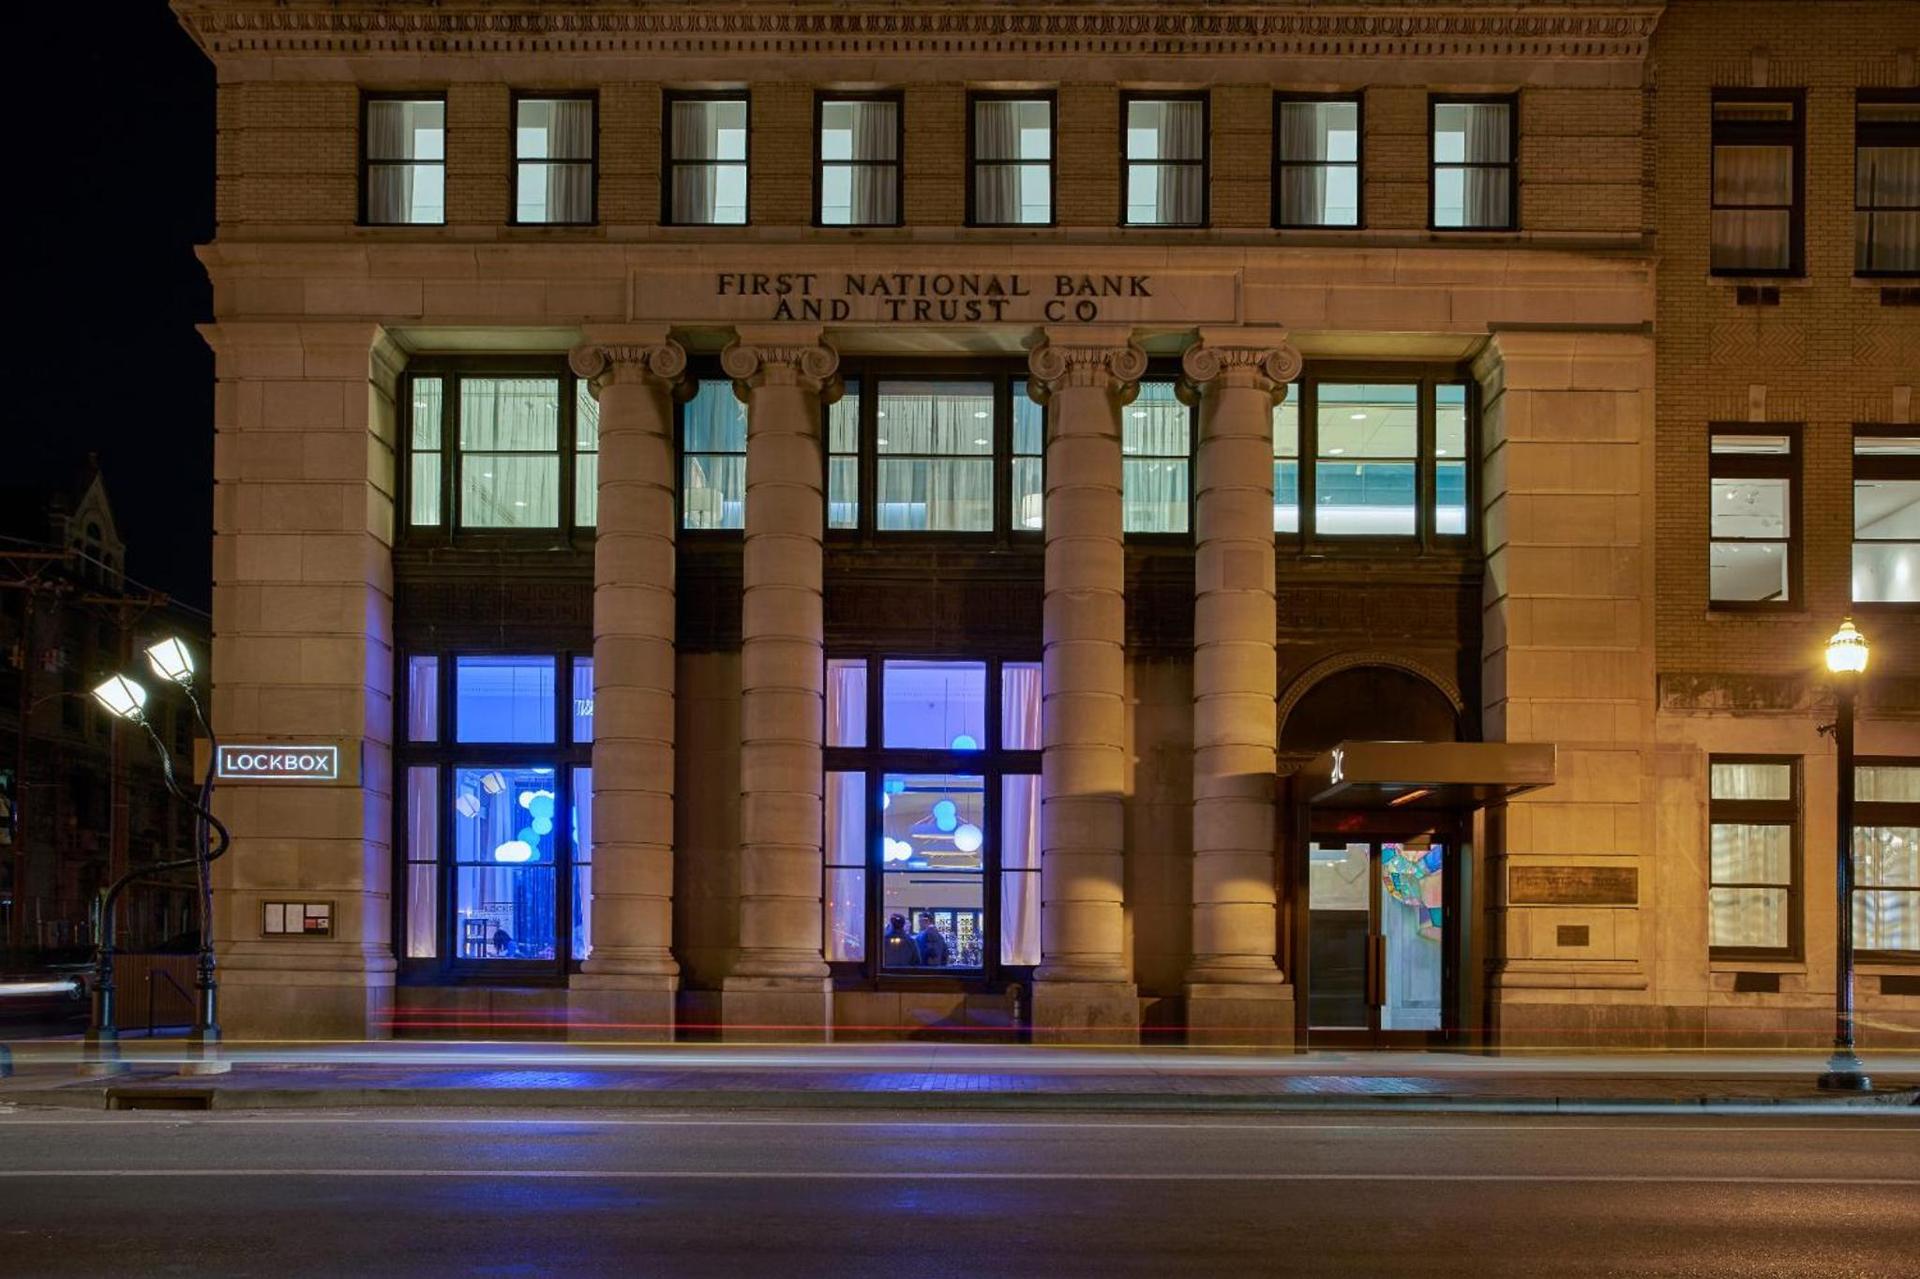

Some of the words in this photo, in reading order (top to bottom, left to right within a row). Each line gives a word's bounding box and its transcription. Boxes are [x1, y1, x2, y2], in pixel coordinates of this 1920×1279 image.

[716, 273, 817, 297] FIRST
[845, 273, 1029, 297] NATIONAL
[1056, 274, 1152, 298] BANK
[772, 298, 851, 322] AND
[885, 298, 1010, 322] TRUST
[1044, 298, 1099, 322] CO
[227, 754, 329, 771] LOCKBOX
